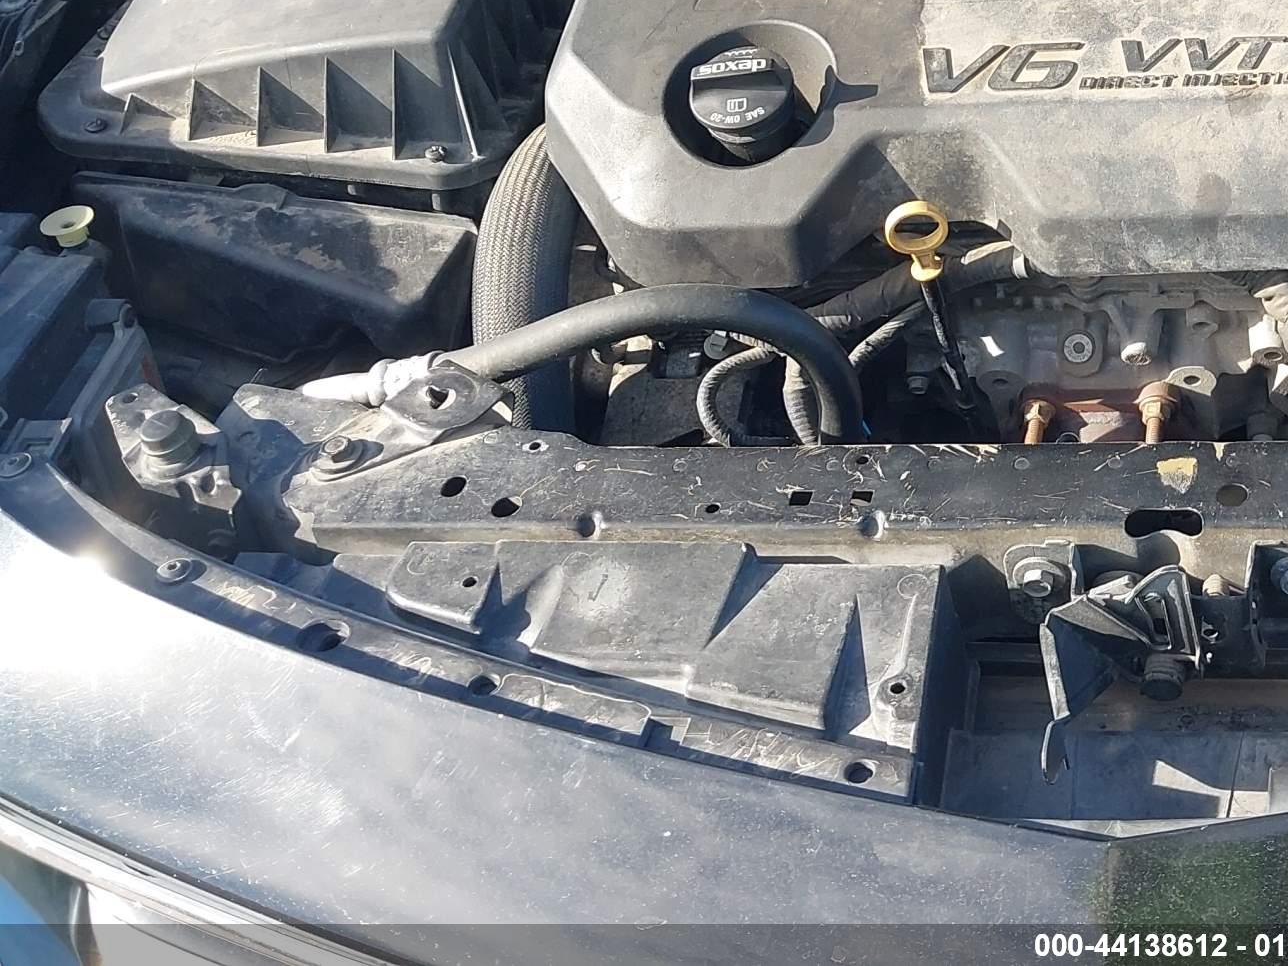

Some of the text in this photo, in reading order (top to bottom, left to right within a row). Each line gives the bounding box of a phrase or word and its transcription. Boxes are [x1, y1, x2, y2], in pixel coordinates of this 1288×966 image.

[698, 58, 767, 76] dexos
[922, 41, 1086, 94] V6
[1078, 73, 1179, 91] DIRECT
[745, 107, 765, 121] SAE
